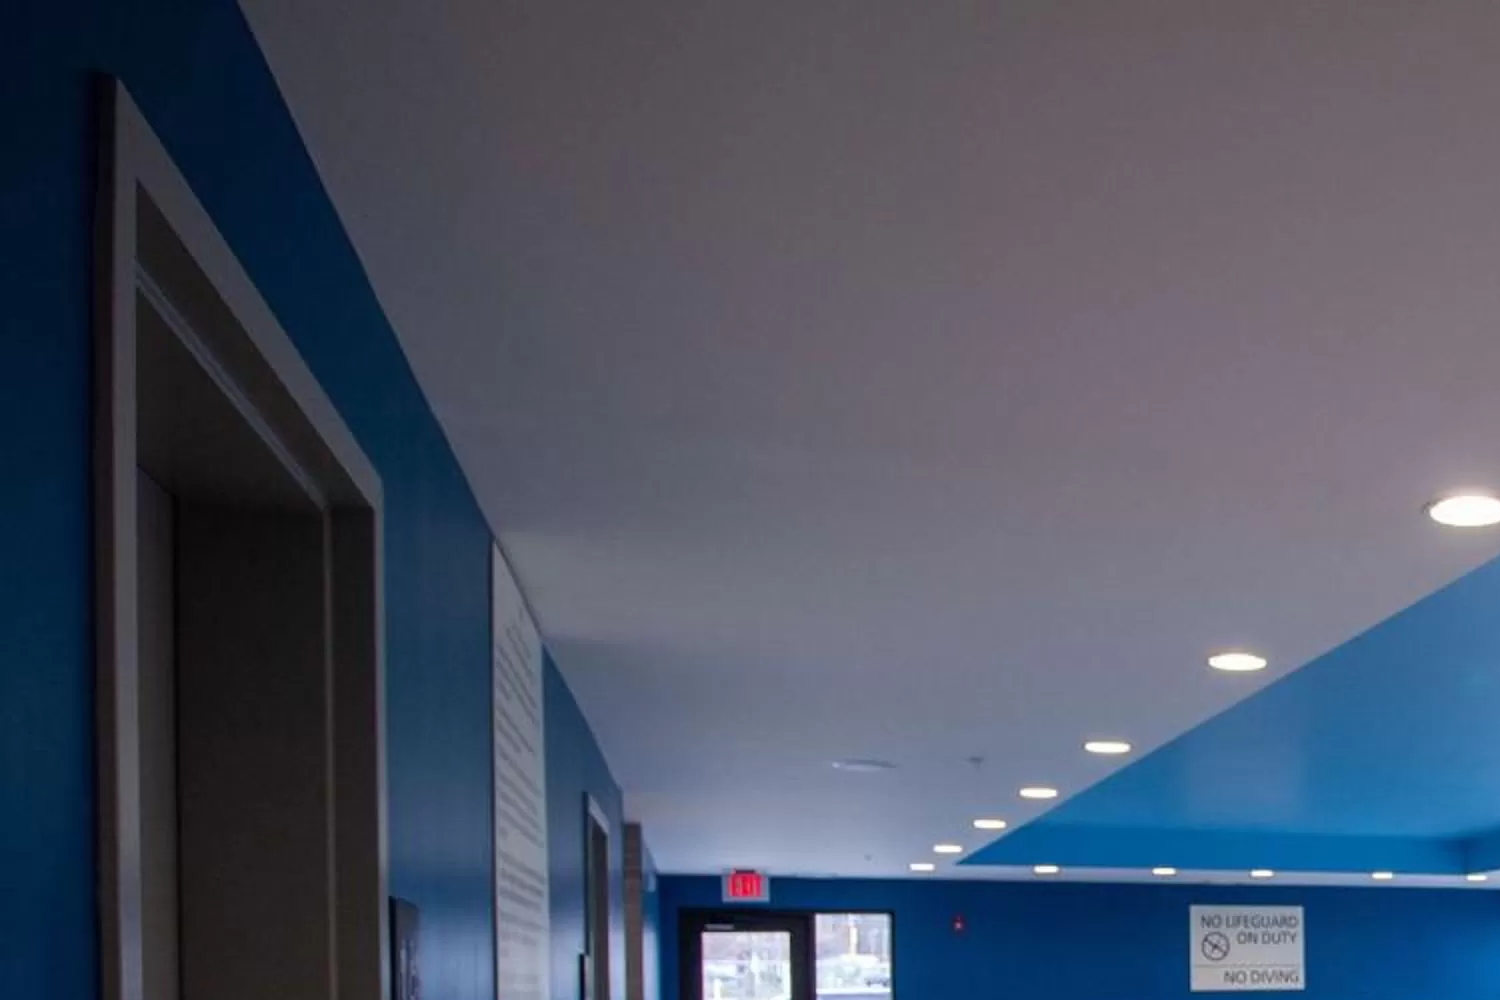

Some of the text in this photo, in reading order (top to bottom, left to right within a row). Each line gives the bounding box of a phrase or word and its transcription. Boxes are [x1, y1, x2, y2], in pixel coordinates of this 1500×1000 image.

[730, 875, 761, 897] EXIT
[1200, 913, 1299, 929] NO LIFEGUARD
[1236, 931, 1297, 945] ON DUTY
[1223, 969, 1299, 984] NO DIVING
